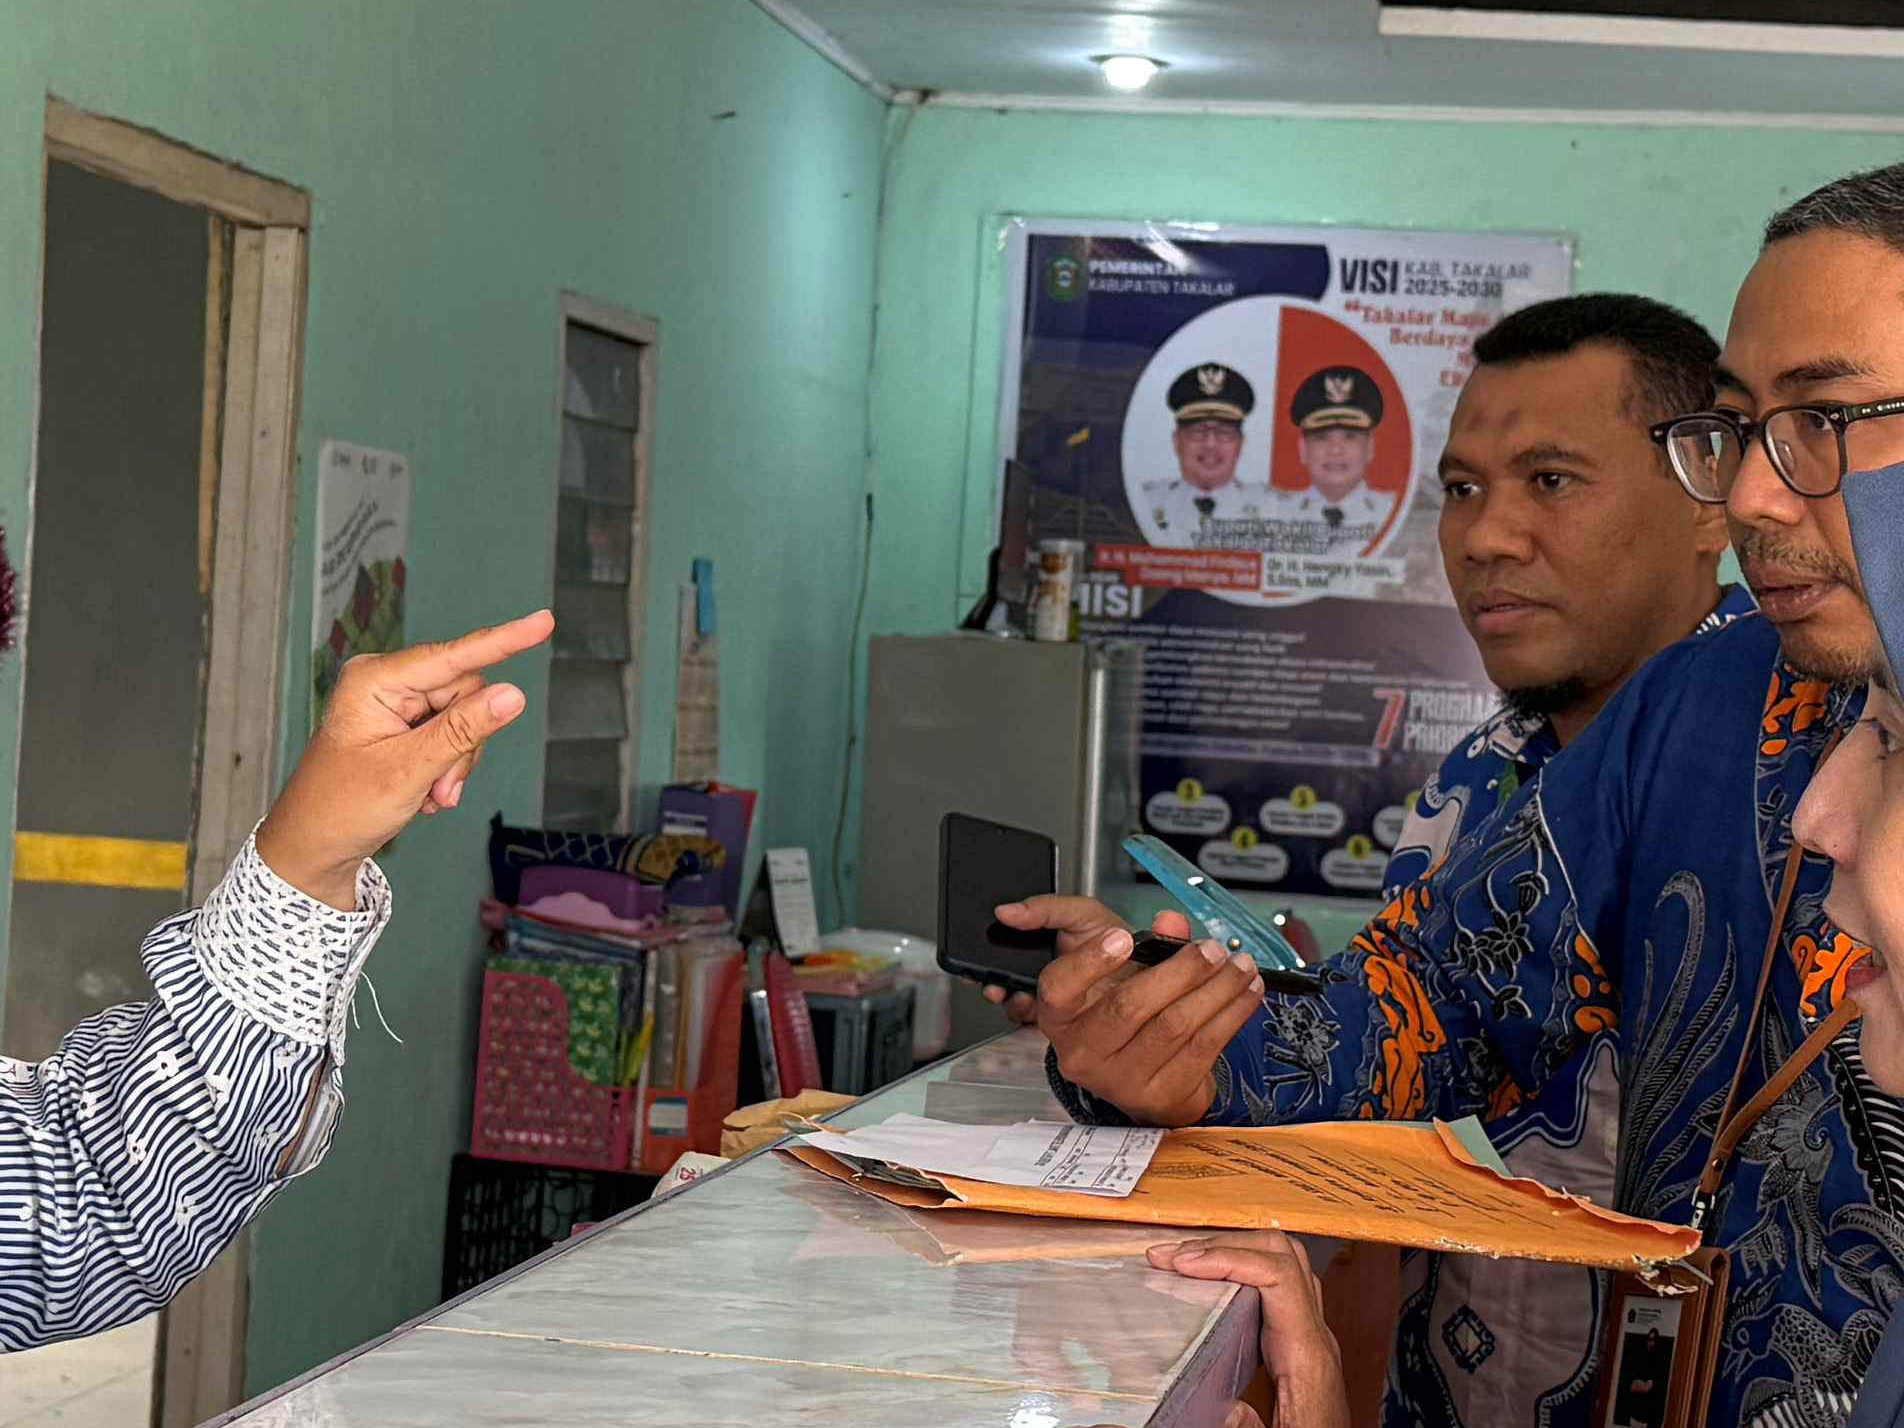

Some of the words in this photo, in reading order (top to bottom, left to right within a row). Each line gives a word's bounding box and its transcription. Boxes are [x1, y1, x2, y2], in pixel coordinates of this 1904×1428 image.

[1340, 257, 1399, 295] VISI
[1452, 261, 1532, 280] TAKALAR
[1088, 278, 1170, 295] KABUPATEN
[1172, 281, 1236, 296] TAKALAR
[1372, 687, 1407, 749] 7
